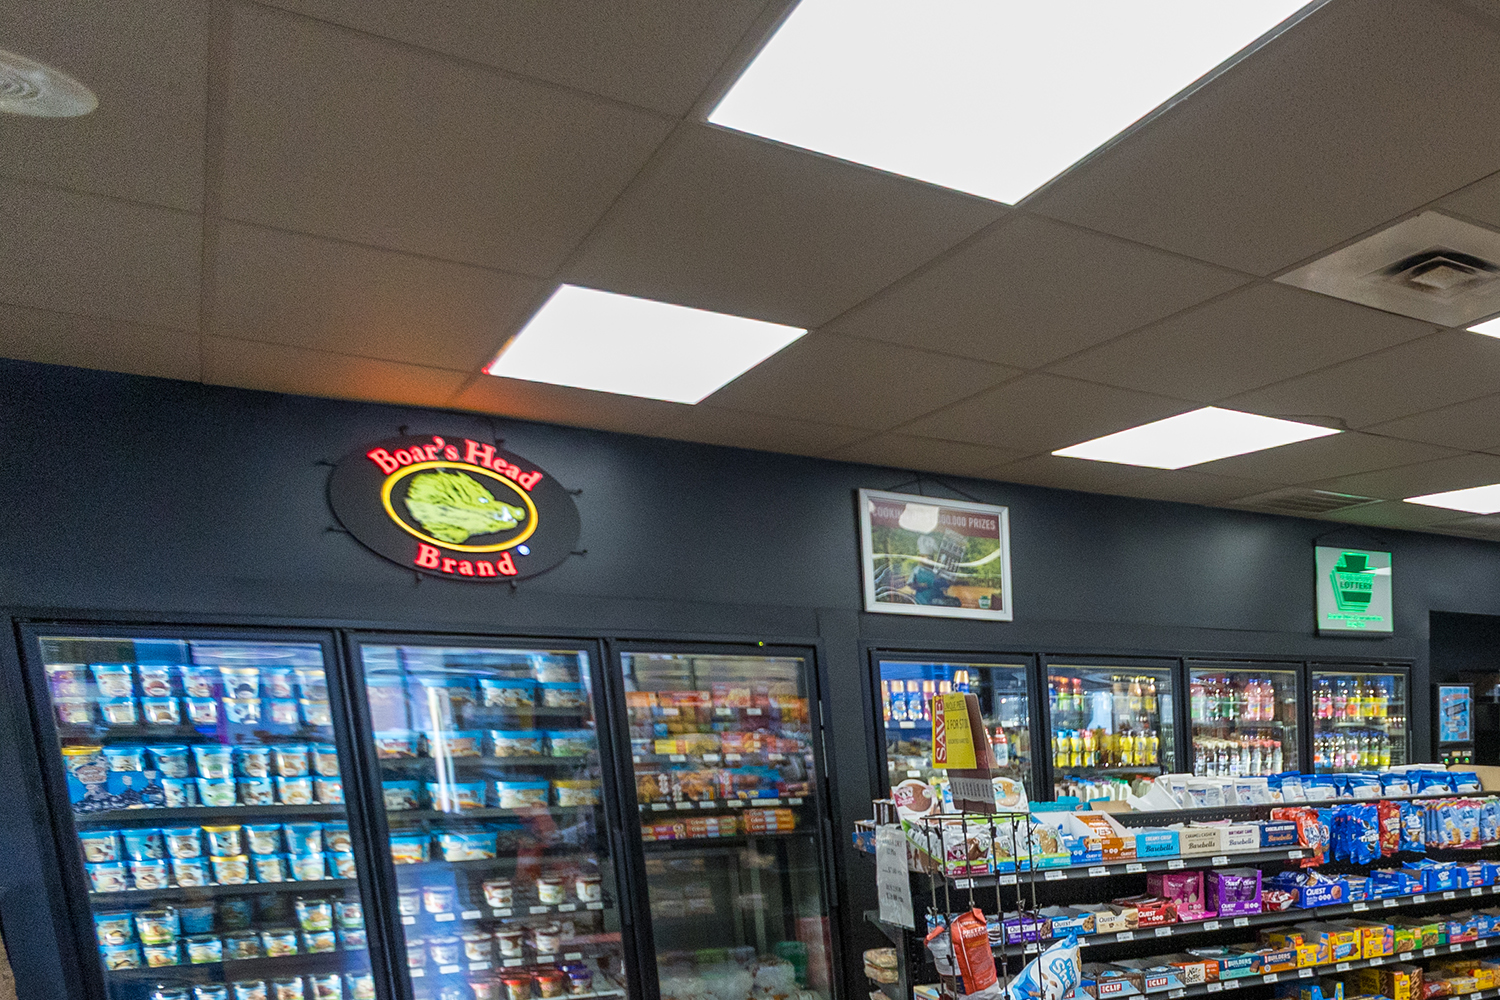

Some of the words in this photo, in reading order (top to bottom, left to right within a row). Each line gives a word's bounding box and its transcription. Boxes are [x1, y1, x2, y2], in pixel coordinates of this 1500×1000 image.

[367, 436, 459, 475] Boar's
[464, 439, 542, 491] Head
[968, 517, 996, 531] PRIZES
[415, 543, 518, 577] Brand
[1340, 581, 1372, 590] LOTTERY
[1228, 837, 1255, 846] Barebells
[1267, 833, 1294, 842] Barebells
[1145, 844, 1174, 853] Barebells
[1188, 840, 1216, 850] Barebells
[1305, 887, 1327, 896] QUEST
[1267, 952, 1291, 963] BUILDERS
[1228, 958, 1252, 967] BUILDERS
[1151, 977, 1168, 987] CLIF
[1106, 983, 1122, 992] CLIF
